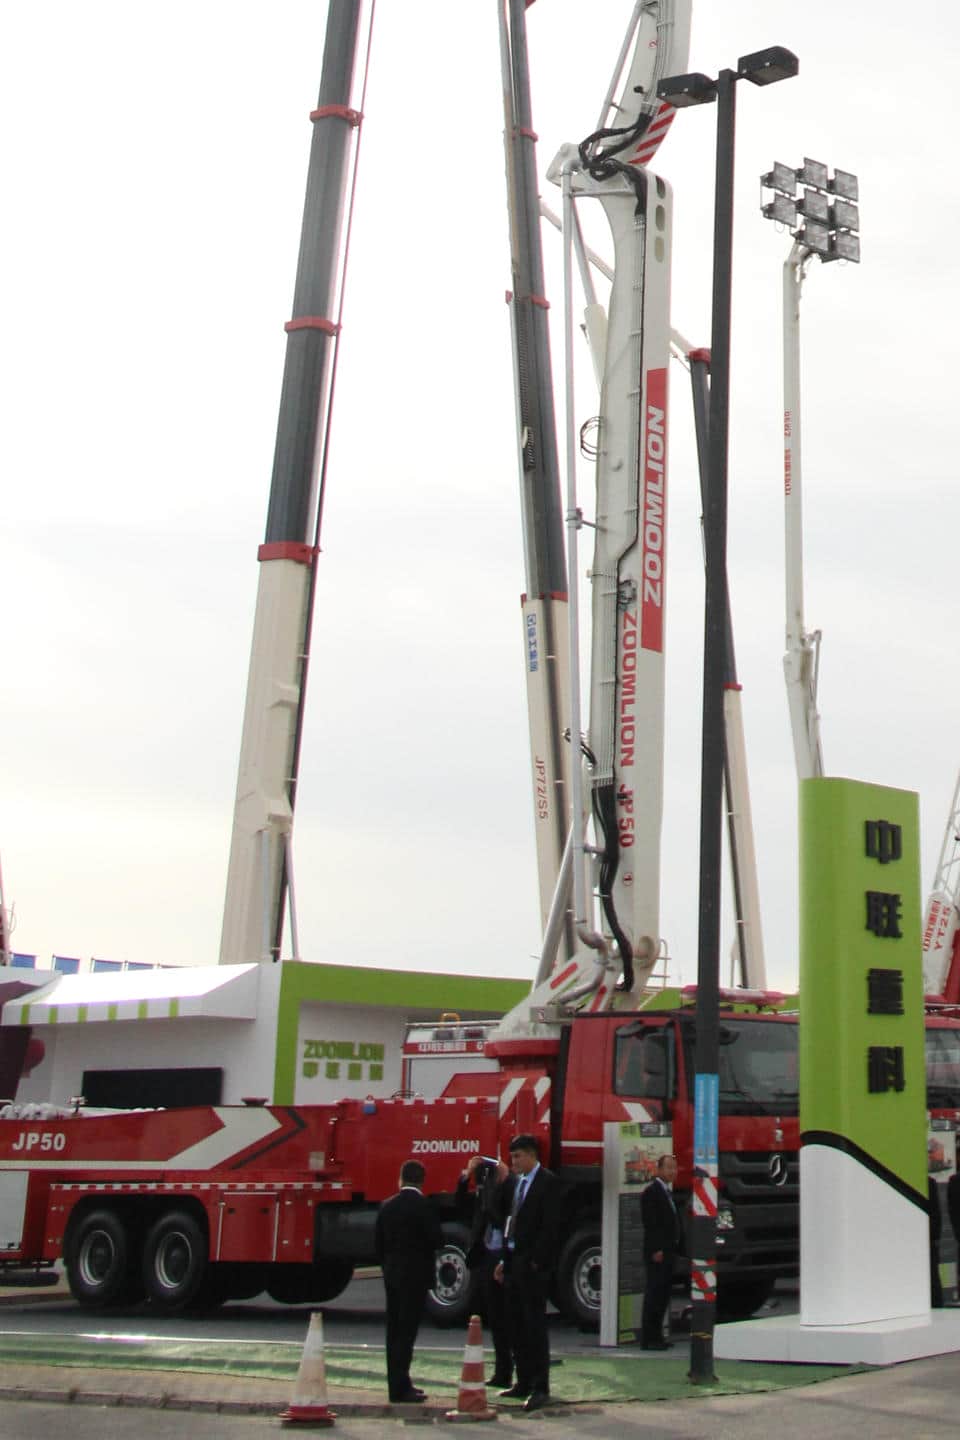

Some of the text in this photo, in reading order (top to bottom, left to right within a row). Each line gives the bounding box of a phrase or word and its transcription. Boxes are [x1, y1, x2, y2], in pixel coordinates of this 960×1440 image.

[644, 405, 665, 608] ZOOMLION
[619, 611, 638, 848] ZOOMLION JP50
[865, 819, 906, 1094] 中联重科
[11, 1132, 67, 1152] JP50
[412, 1139, 480, 1154] ZOOMLION
